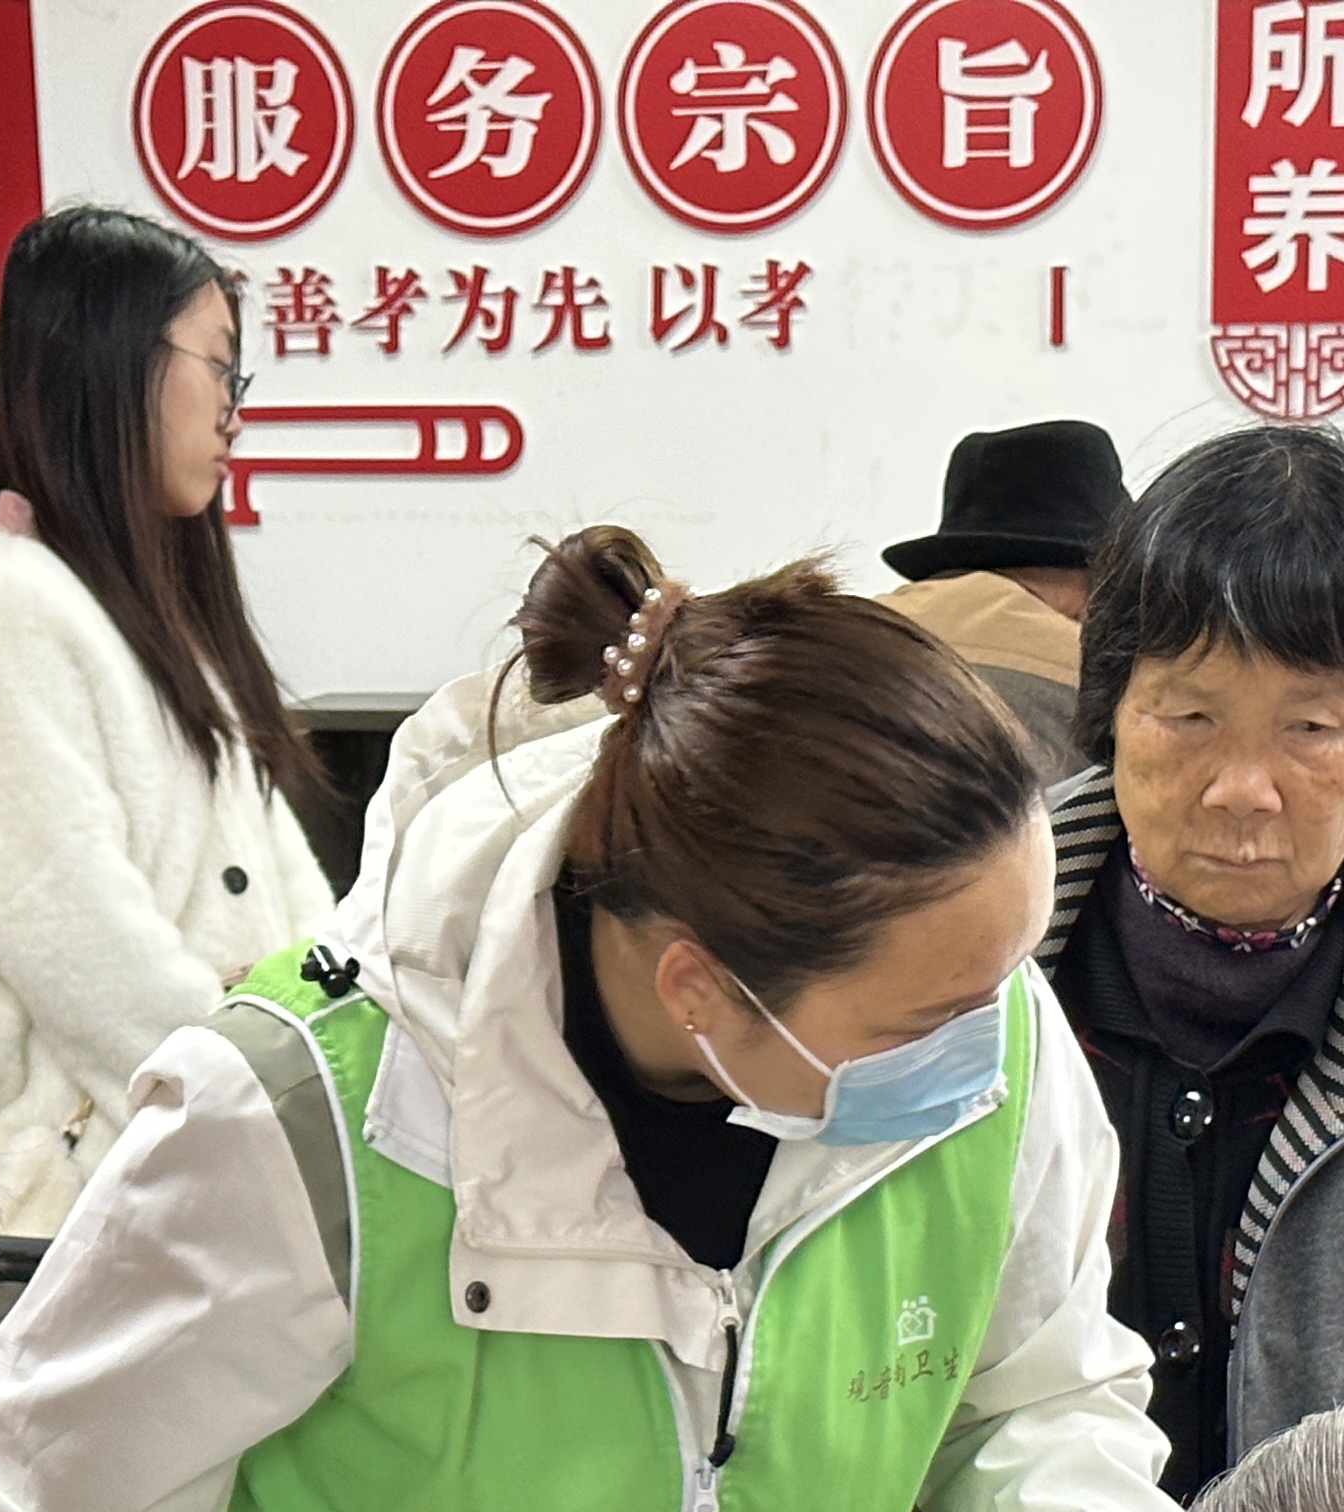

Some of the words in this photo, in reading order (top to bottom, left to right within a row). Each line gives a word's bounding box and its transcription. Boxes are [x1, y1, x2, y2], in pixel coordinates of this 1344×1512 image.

[178, 38, 1054, 184] 服务宗旨
[234, 263, 613, 357] 善孝为先
